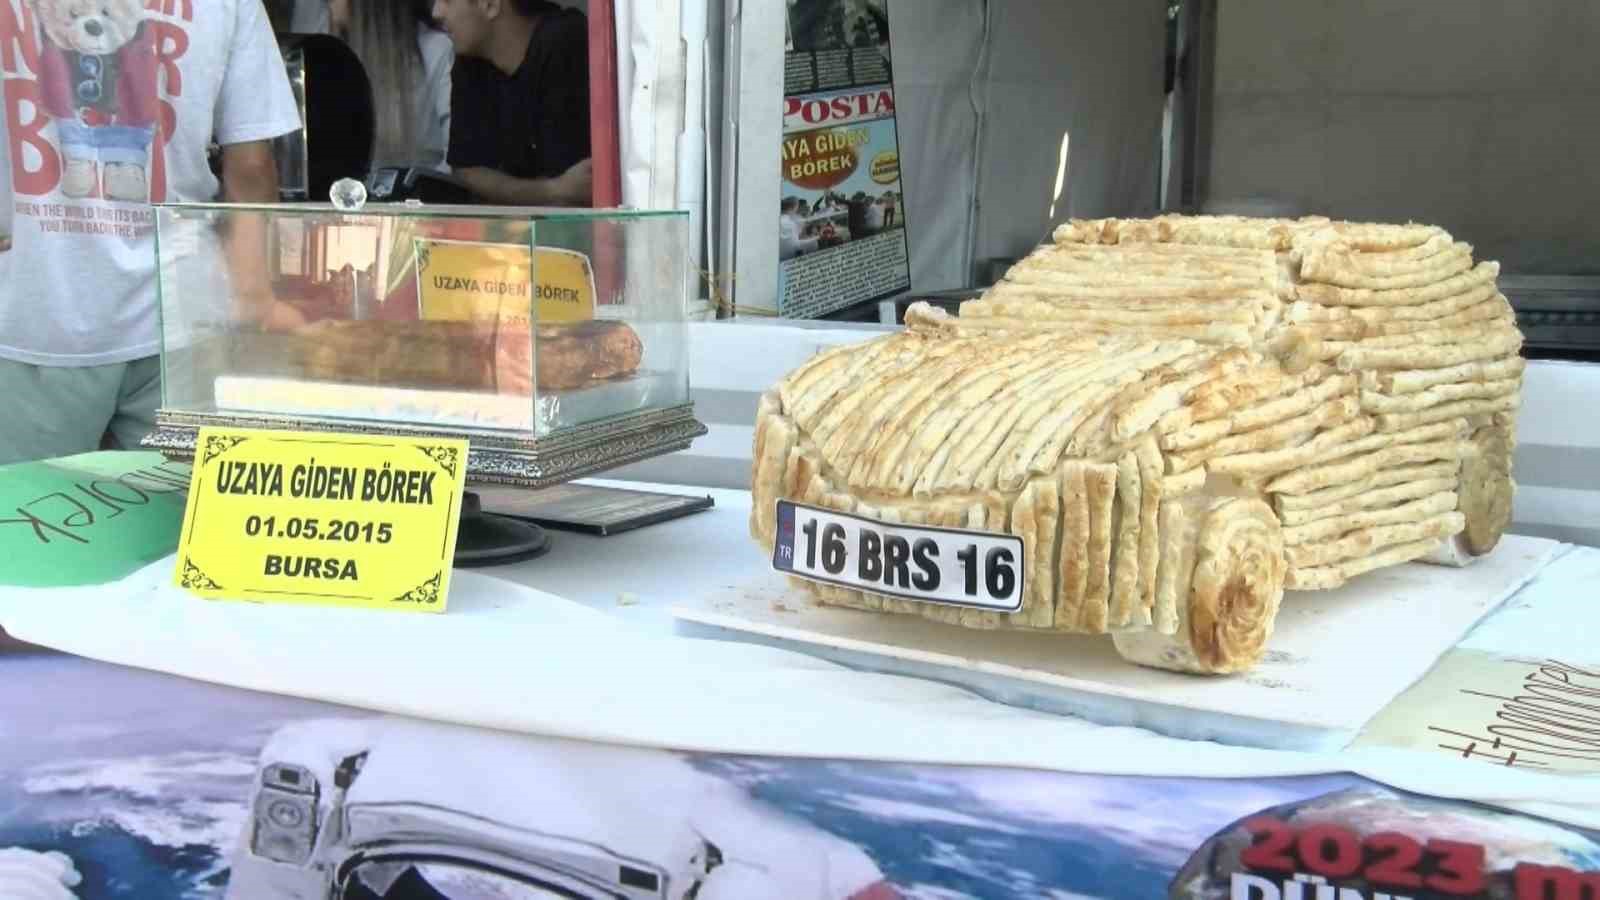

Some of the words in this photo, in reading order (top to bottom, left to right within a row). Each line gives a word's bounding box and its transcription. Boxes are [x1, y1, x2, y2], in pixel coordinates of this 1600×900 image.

[434, 276, 480, 293] UZAYA
[217, 461, 283, 496] UZAYA
[290, 457, 357, 500] GİDEN
[361, 462, 436, 505] BÖREK
[245, 515, 393, 544] 01.05.2015
[779, 545, 792, 560] TR
[803, 518, 848, 575] 16
[858, 527, 941, 592] BRS
[957, 543, 1016, 600] 16
[264, 554, 358, 581] BURSA
[1240, 816, 1486, 895] 2023
